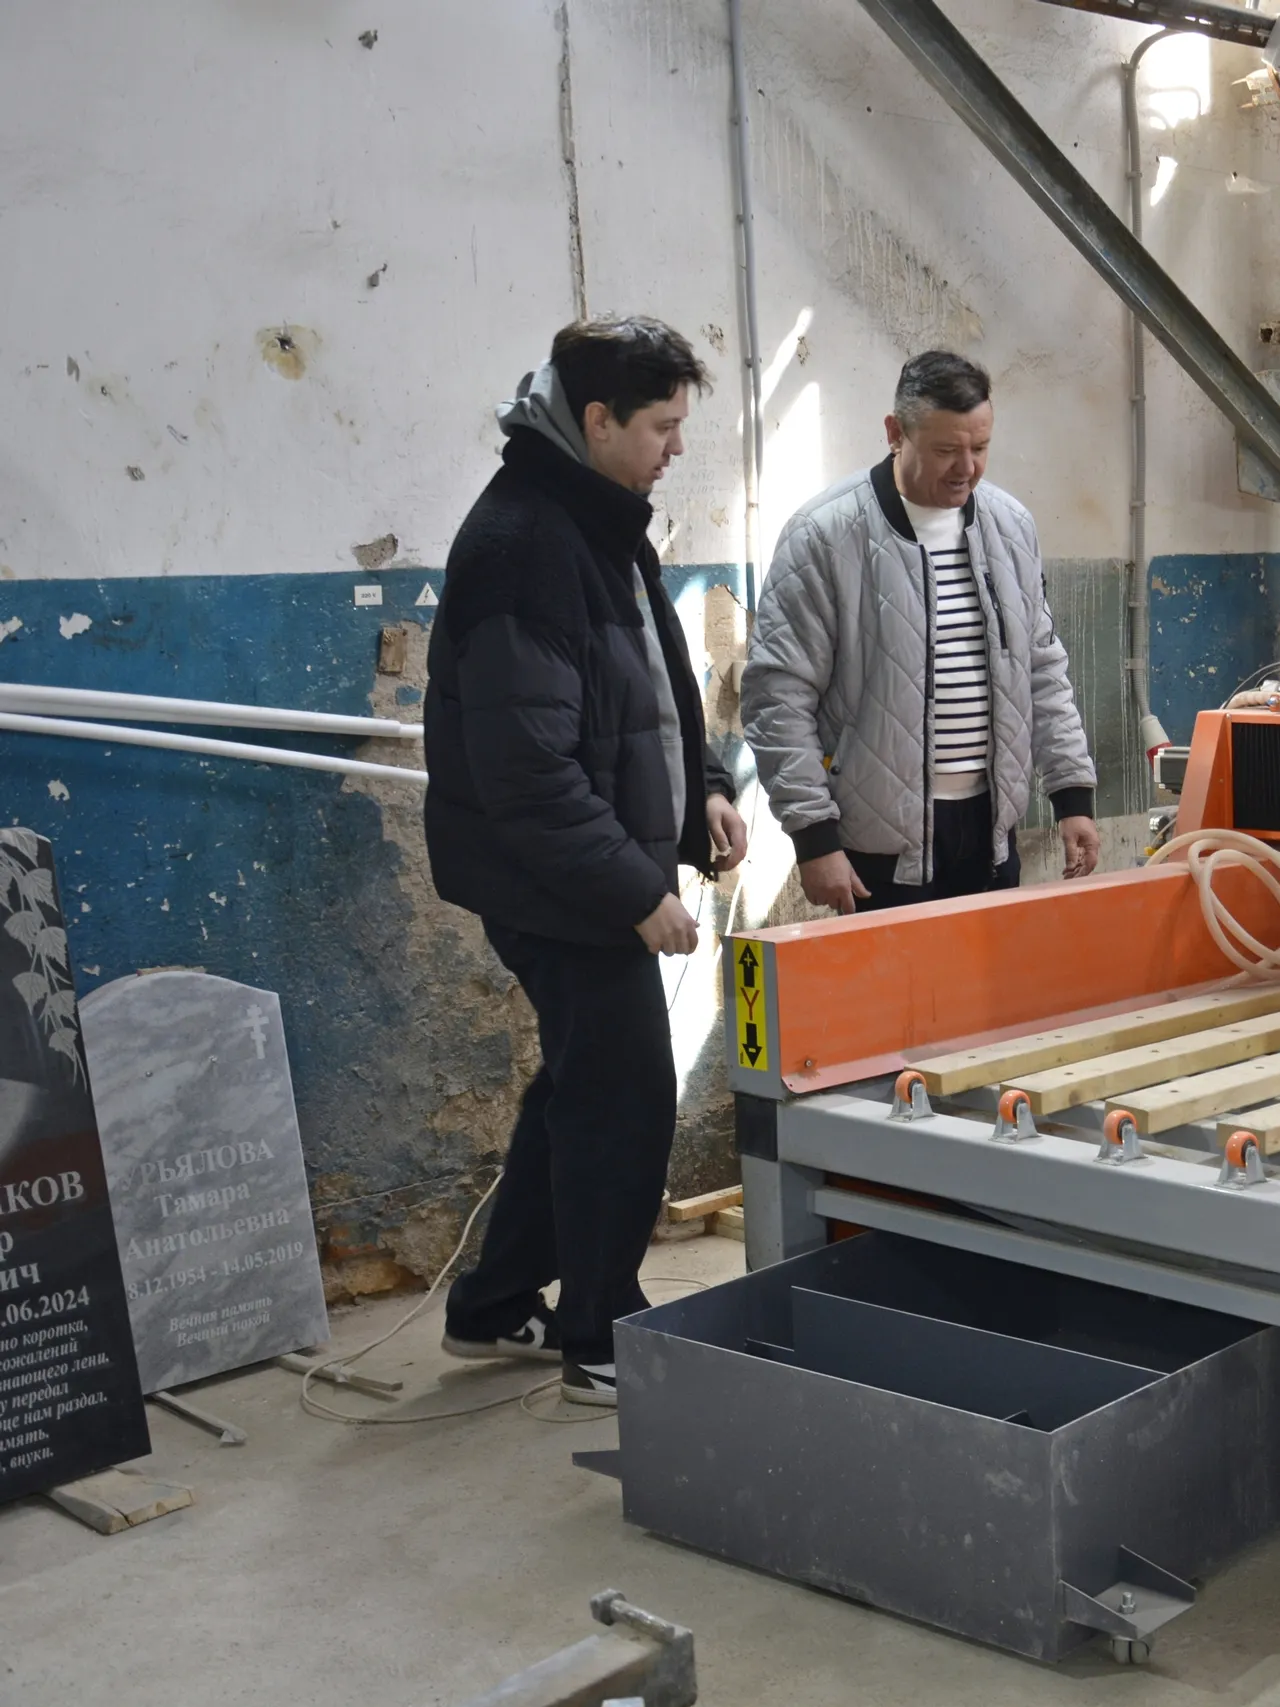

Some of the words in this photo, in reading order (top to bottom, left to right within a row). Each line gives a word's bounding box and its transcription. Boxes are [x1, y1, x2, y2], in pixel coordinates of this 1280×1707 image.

[740, 986, 760, 1021] Y
[0, 1171, 84, 1214] КОВ
[154, 1182, 251, 1218] Тамара
[125, 1207, 290, 1262] Анатольевна
[223, 1241, 304, 1276] 14.05.2019
[1, 1285, 90, 1327] .06.2024
[169, 1309, 218, 1333] Вечная
[221, 1296, 273, 1319] память
[22, 1319, 88, 1347] коротка,
[177, 1321, 229, 1348] Вечный
[232, 1310, 271, 1332] покой
[0, 1337, 78, 1372] ожалений
[0, 1364, 68, 1393] нающего
[72, 1351, 110, 1373] лени.
[0, 1416, 20, 1433] це
[23, 1406, 53, 1426] нам
[56, 1391, 108, 1420] раздал.
[12, 1381, 69, 1409] передал
[10, 1447, 54, 1469] внуки.
